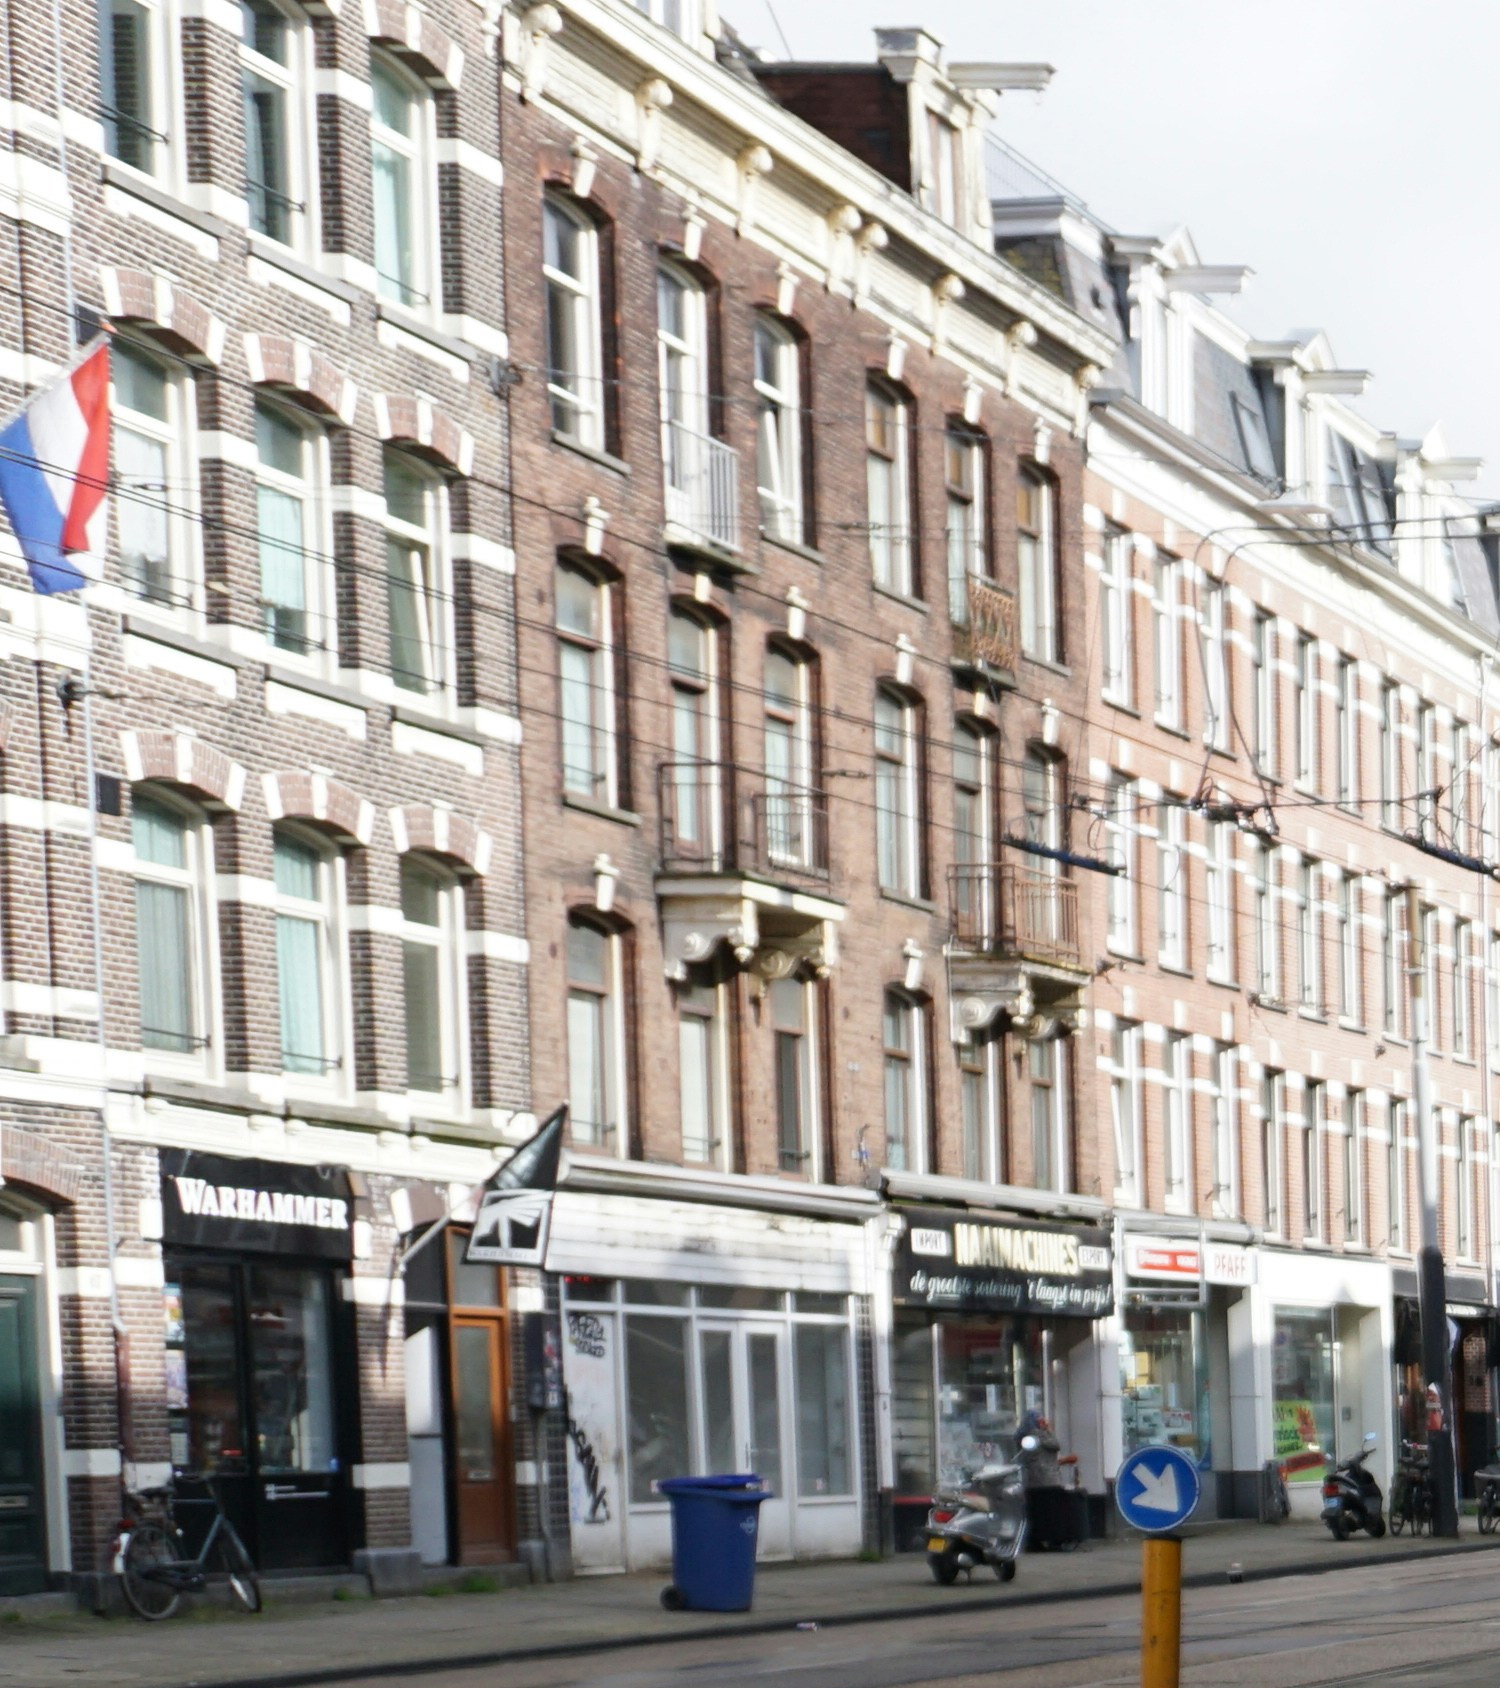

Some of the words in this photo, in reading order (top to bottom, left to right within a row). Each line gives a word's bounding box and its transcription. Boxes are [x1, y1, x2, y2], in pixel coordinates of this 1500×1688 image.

[176, 1176, 348, 1230] WARHAMMER
[954, 1222, 1081, 1276] NAAIMACHINES
[1213, 1254, 1246, 1278] PFAFF
[910, 1270, 926, 1292] de
[1035, 1277, 1068, 1310] laagst
[1069, 1287, 1082, 1303] in
